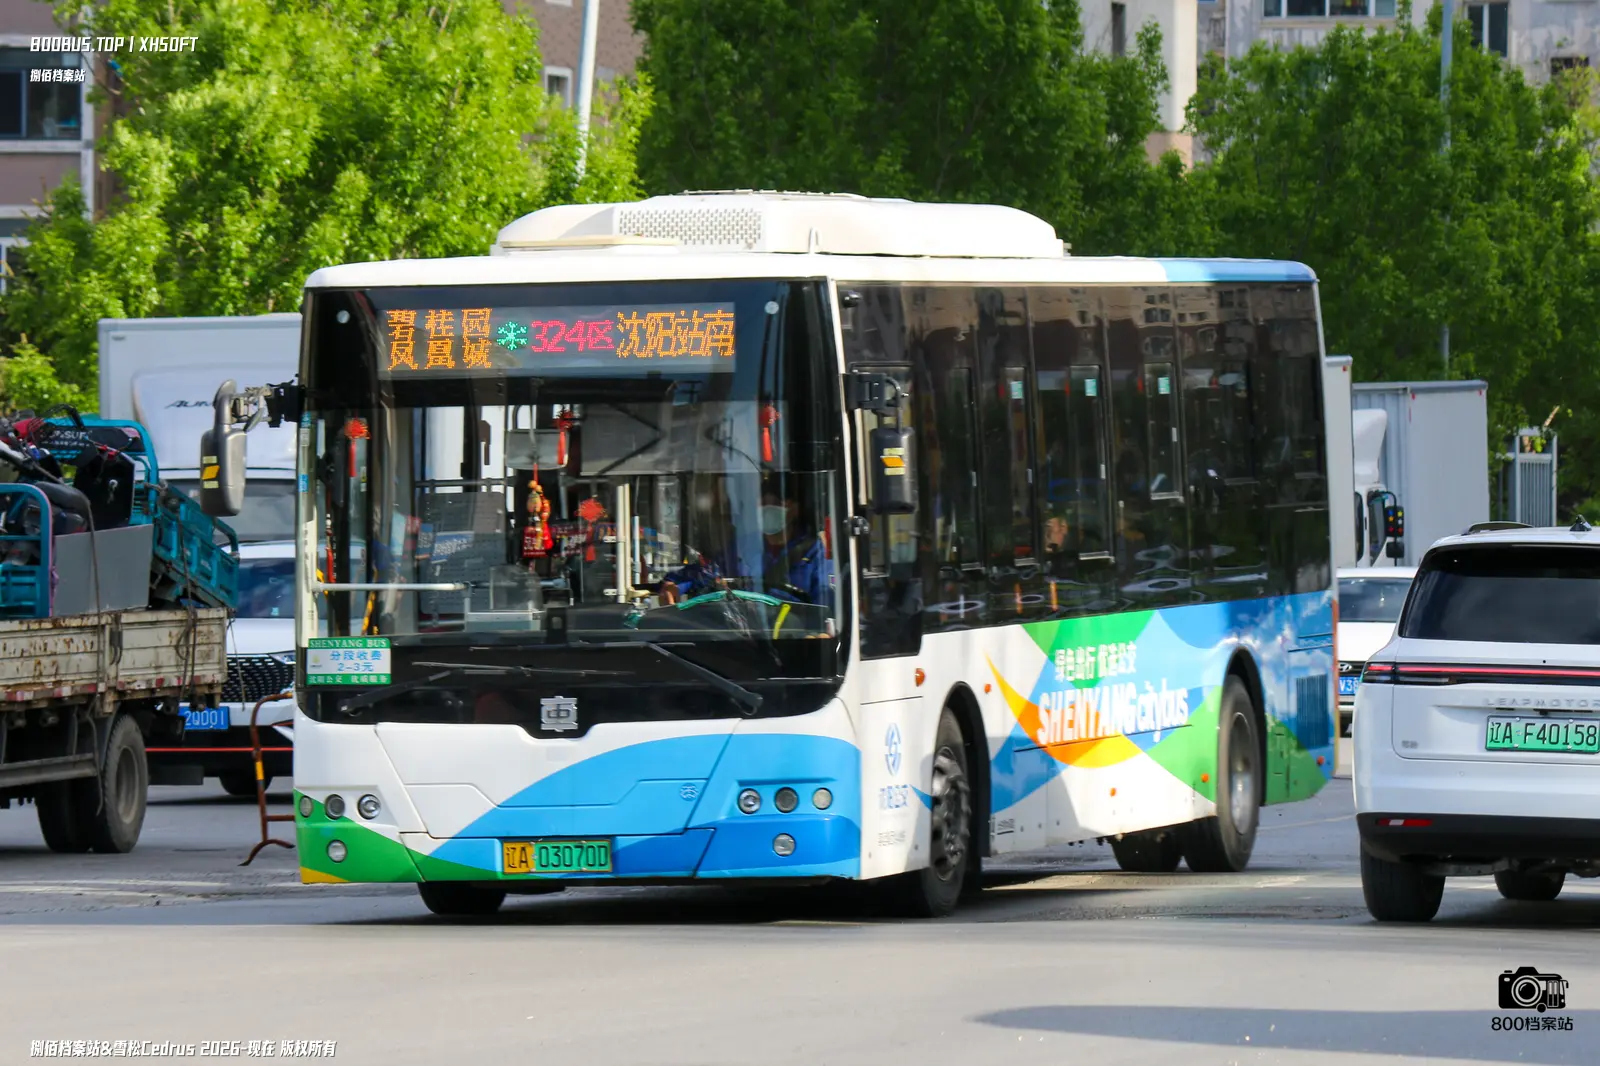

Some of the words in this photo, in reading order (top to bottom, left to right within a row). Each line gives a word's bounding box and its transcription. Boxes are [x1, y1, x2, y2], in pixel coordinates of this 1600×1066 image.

[531, 319, 615, 352] 324区
[616, 310, 736, 358] 沈阳站南
[310, 639, 363, 649] SHENYANG
[367, 639, 387, 648] BUS
[329, 650, 382, 661] 分段收费
[337, 661, 374, 672] 2-3元
[1036, 681, 1137, 746] SHENYANG
[1490, 721, 1513, 744] 辽A
[1523, 722, 1597, 747] F40158
[506, 846, 530, 868] 辽A
[539, 845, 609, 868] 03070D
